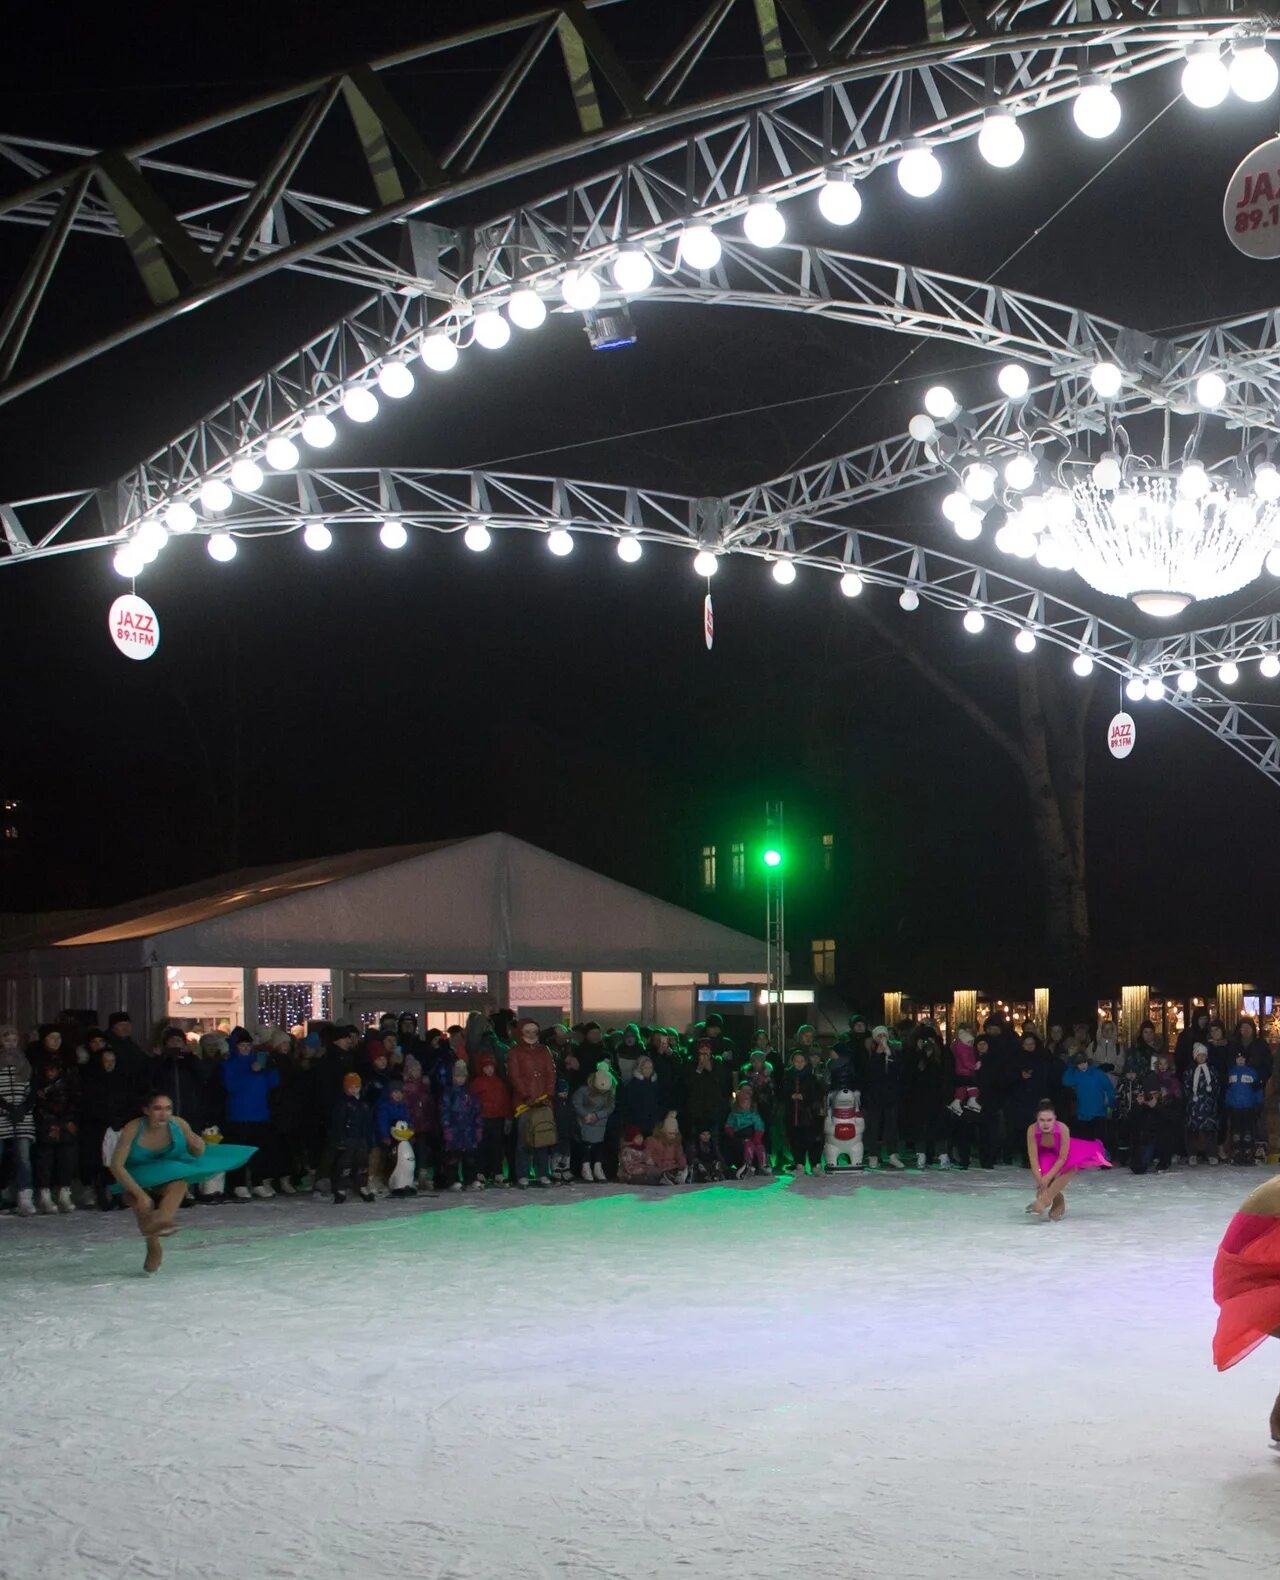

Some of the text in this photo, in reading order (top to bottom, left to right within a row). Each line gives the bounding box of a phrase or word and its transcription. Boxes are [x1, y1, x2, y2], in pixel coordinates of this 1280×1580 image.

[1234, 204, 1280, 233] 89.1
[117, 609, 154, 633] JAZZ
[117, 628, 154, 647] 89.1 FM
[1111, 724, 1132, 739] JAZZ
